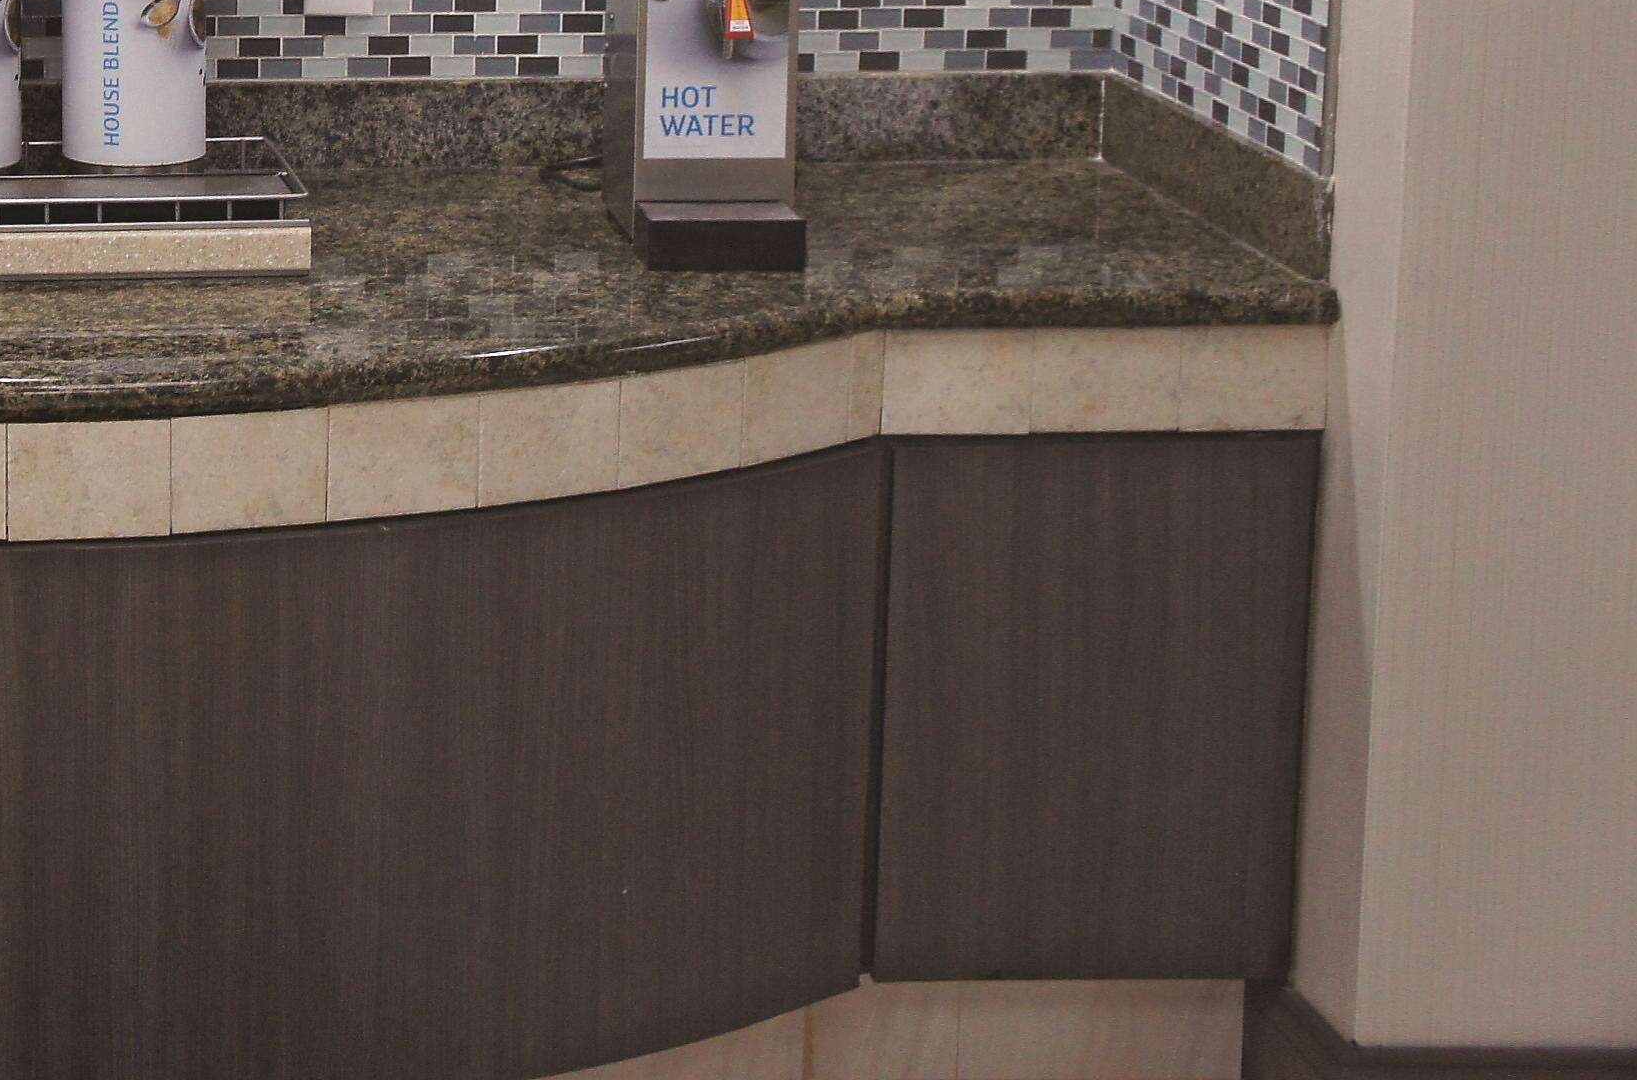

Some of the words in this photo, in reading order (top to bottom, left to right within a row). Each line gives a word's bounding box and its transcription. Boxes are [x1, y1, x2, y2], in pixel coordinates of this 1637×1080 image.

[102, 0, 119, 69] BLEND
[103, 77, 120, 146] HOUSE
[662, 86, 717, 108] HOT
[660, 114, 755, 136] WATER
